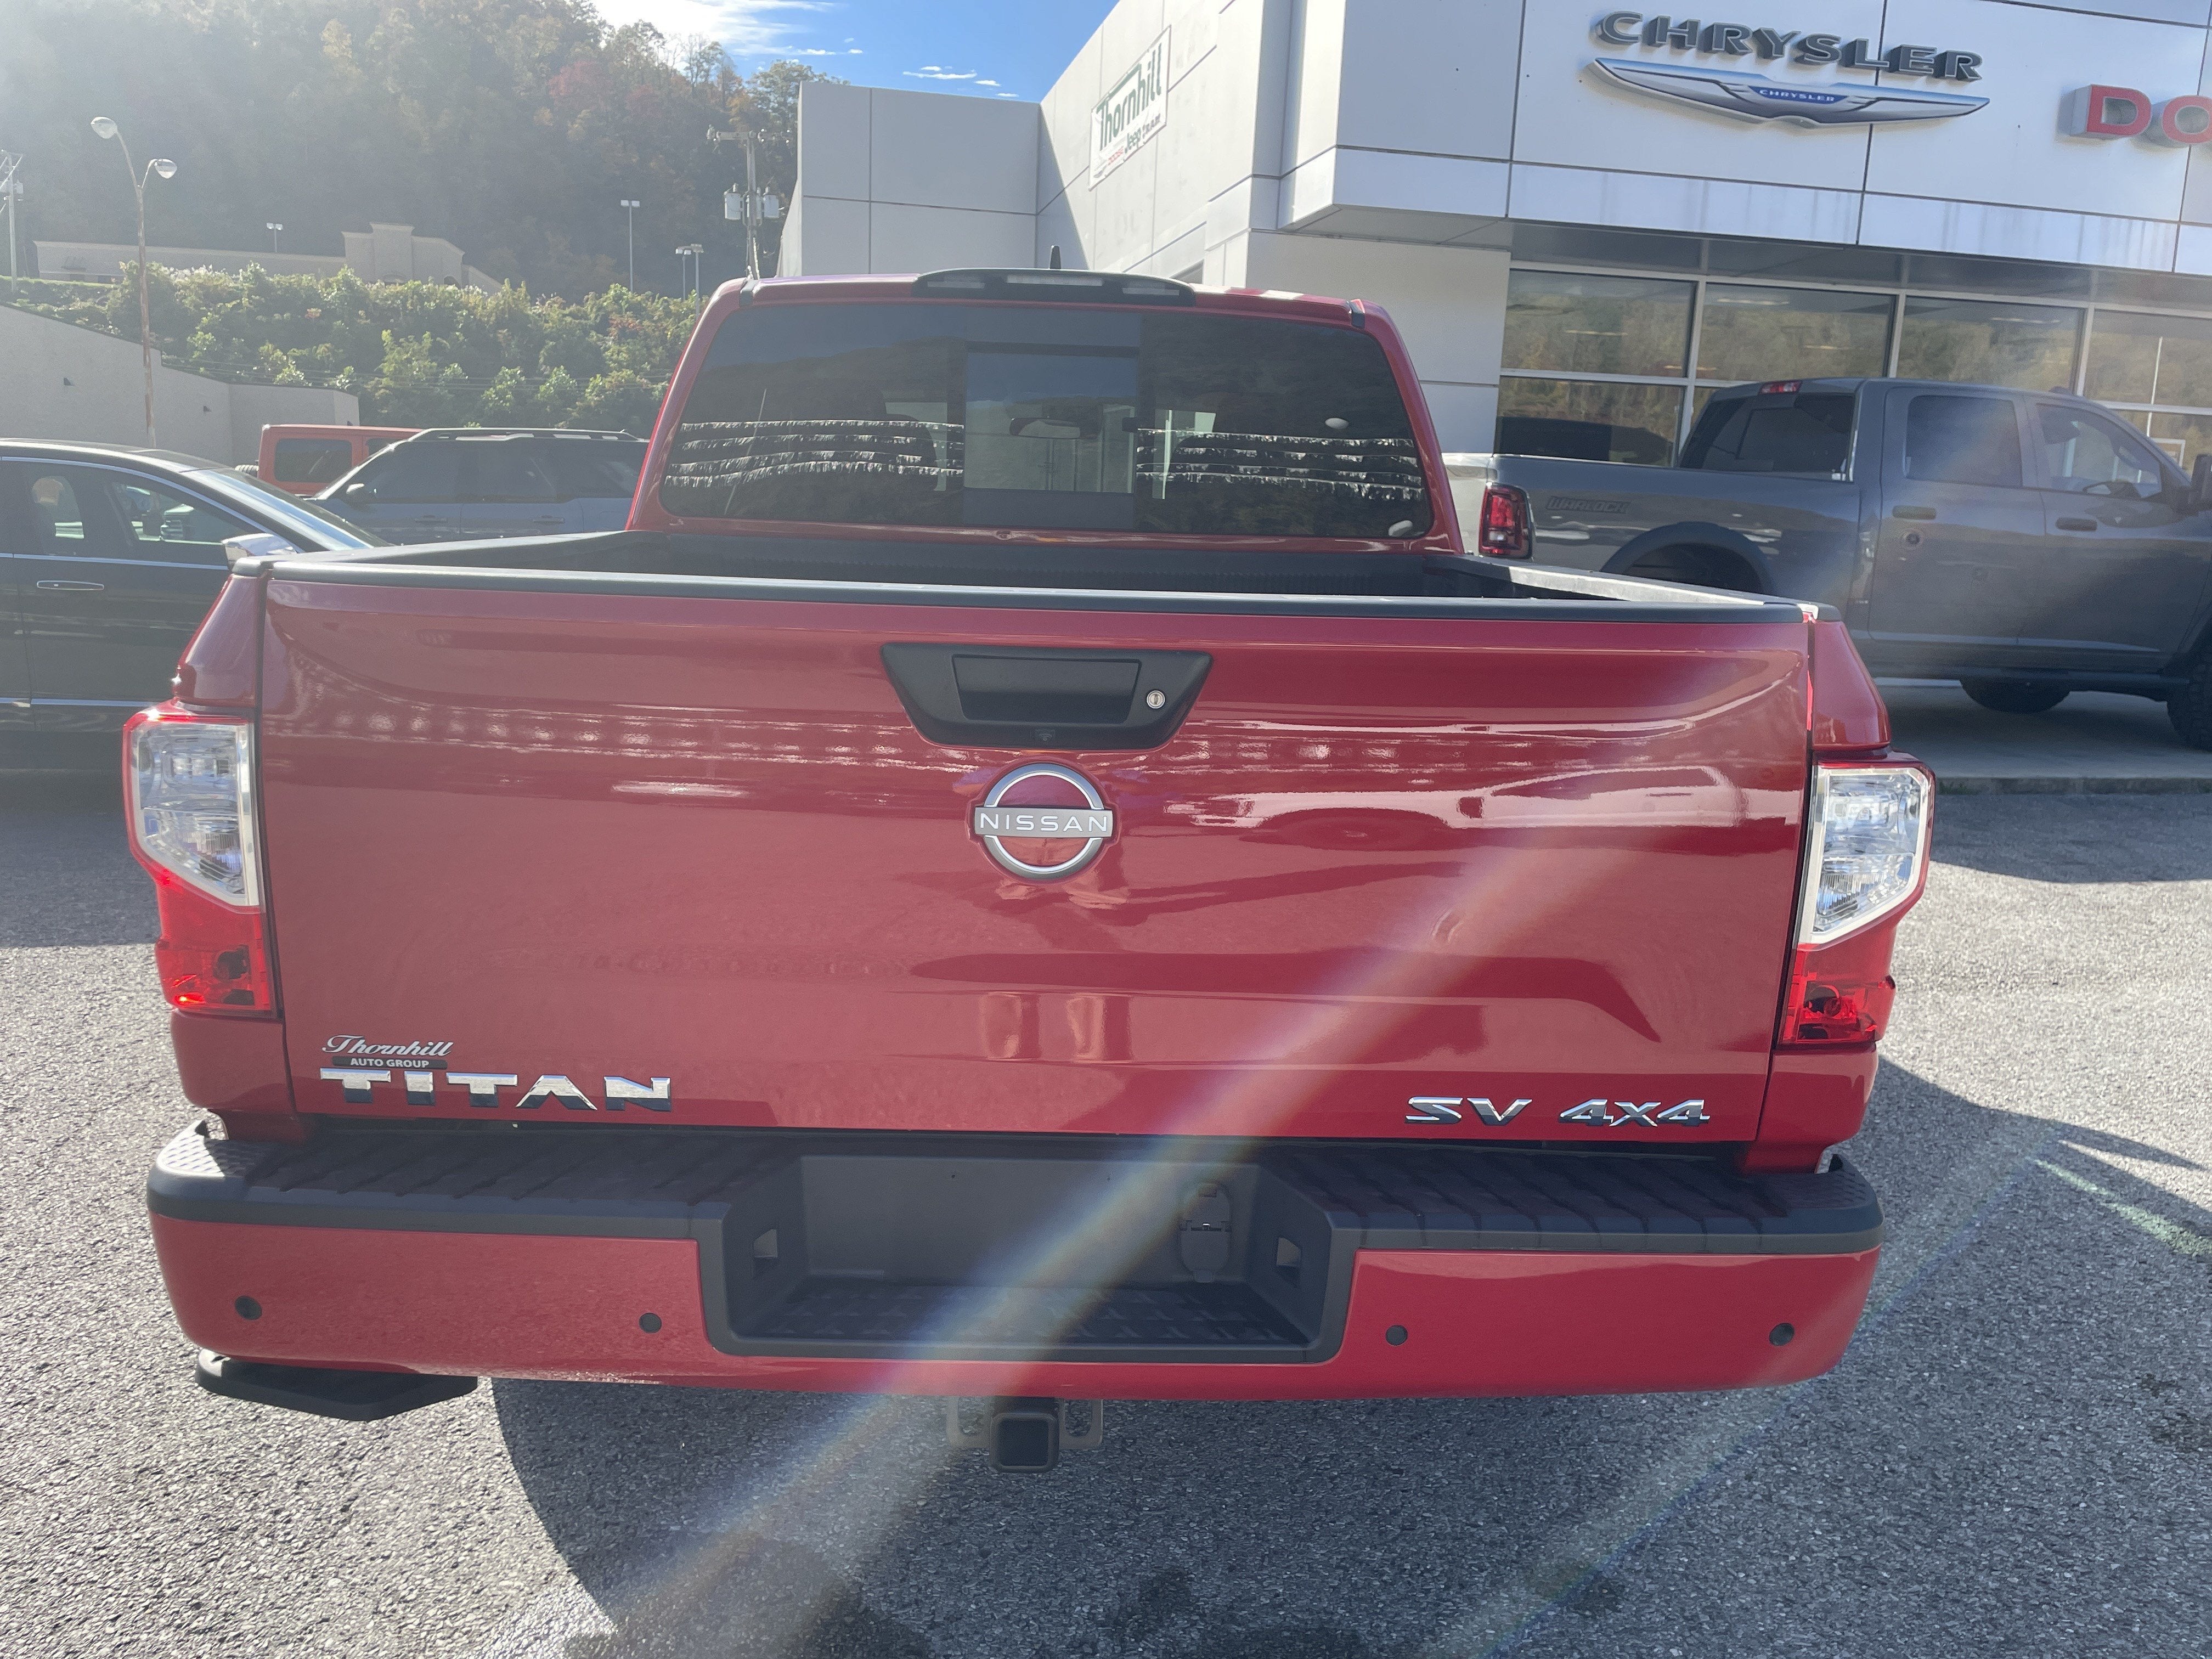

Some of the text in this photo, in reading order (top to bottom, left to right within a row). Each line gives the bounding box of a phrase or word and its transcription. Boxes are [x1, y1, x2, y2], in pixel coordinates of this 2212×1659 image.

[1596, 11, 1984, 82] CHRYSLER
[1096, 43, 1162, 151] Thornhill
[1759, 89, 1835, 101] CHRYSLER
[980, 812, 1107, 832] NISSAN
[321, 1035, 454, 1056] Thornhill
[350, 1057, 430, 1068] AUTO GROUP
[320, 1068, 672, 1112] TITAN
[1405, 1096, 1533, 1126] SV
